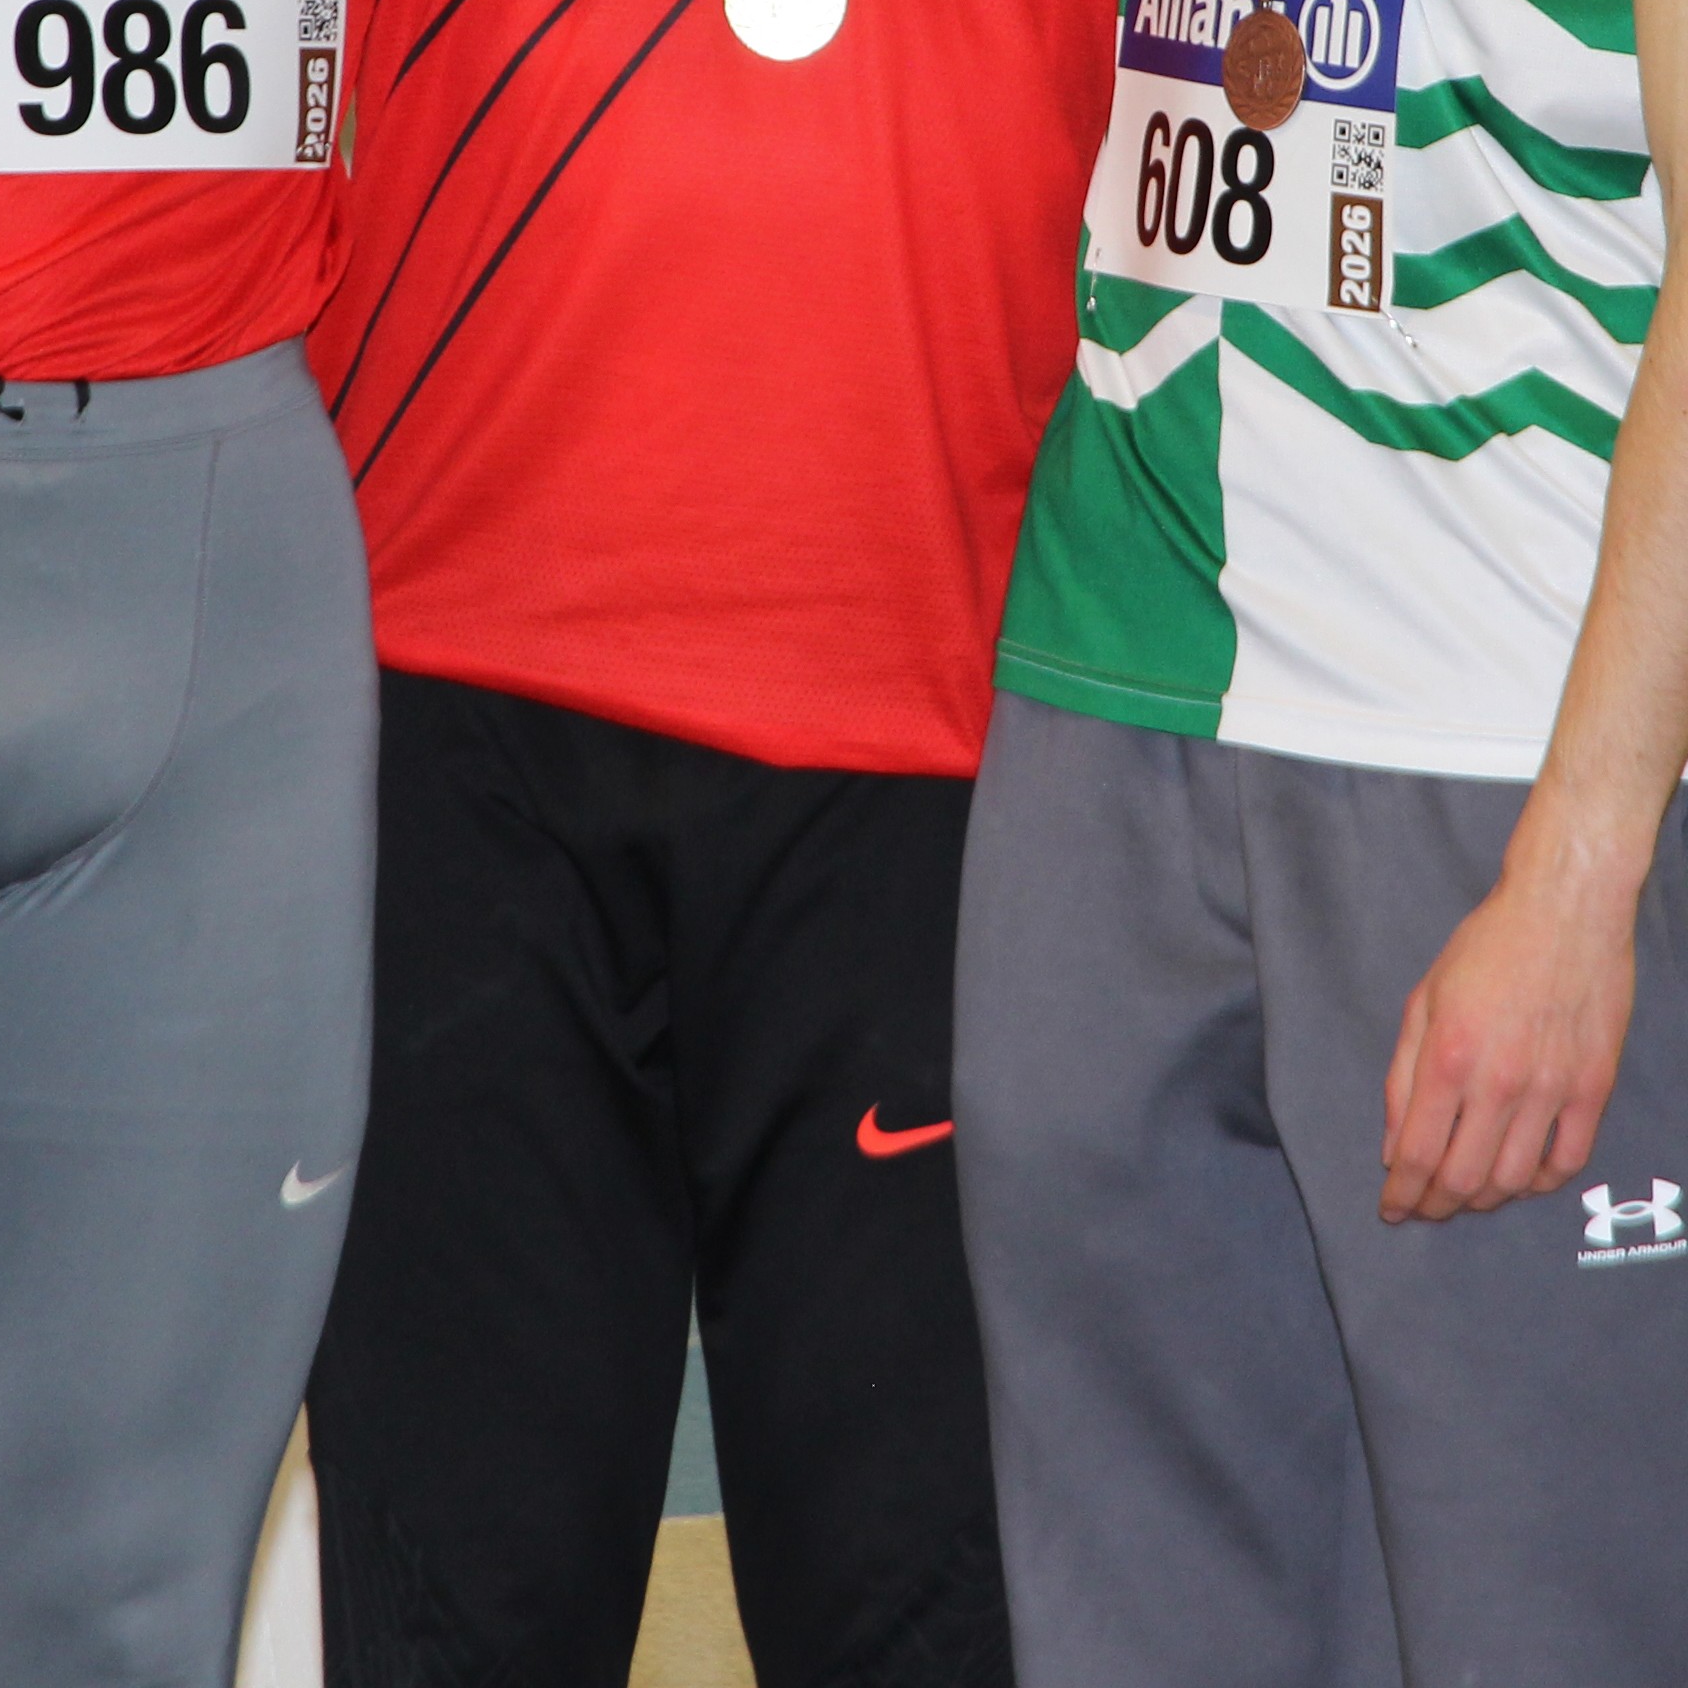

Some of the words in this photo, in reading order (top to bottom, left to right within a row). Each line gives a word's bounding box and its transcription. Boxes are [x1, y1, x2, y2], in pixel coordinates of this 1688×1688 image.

[303, 56, 330, 160] 2026
[1136, 110, 1275, 266] 608
[1339, 202, 1374, 308] 2026
[1577, 1246, 1626, 1264] UNDER
[1627, 1238, 1688, 1259] ARMOUR
